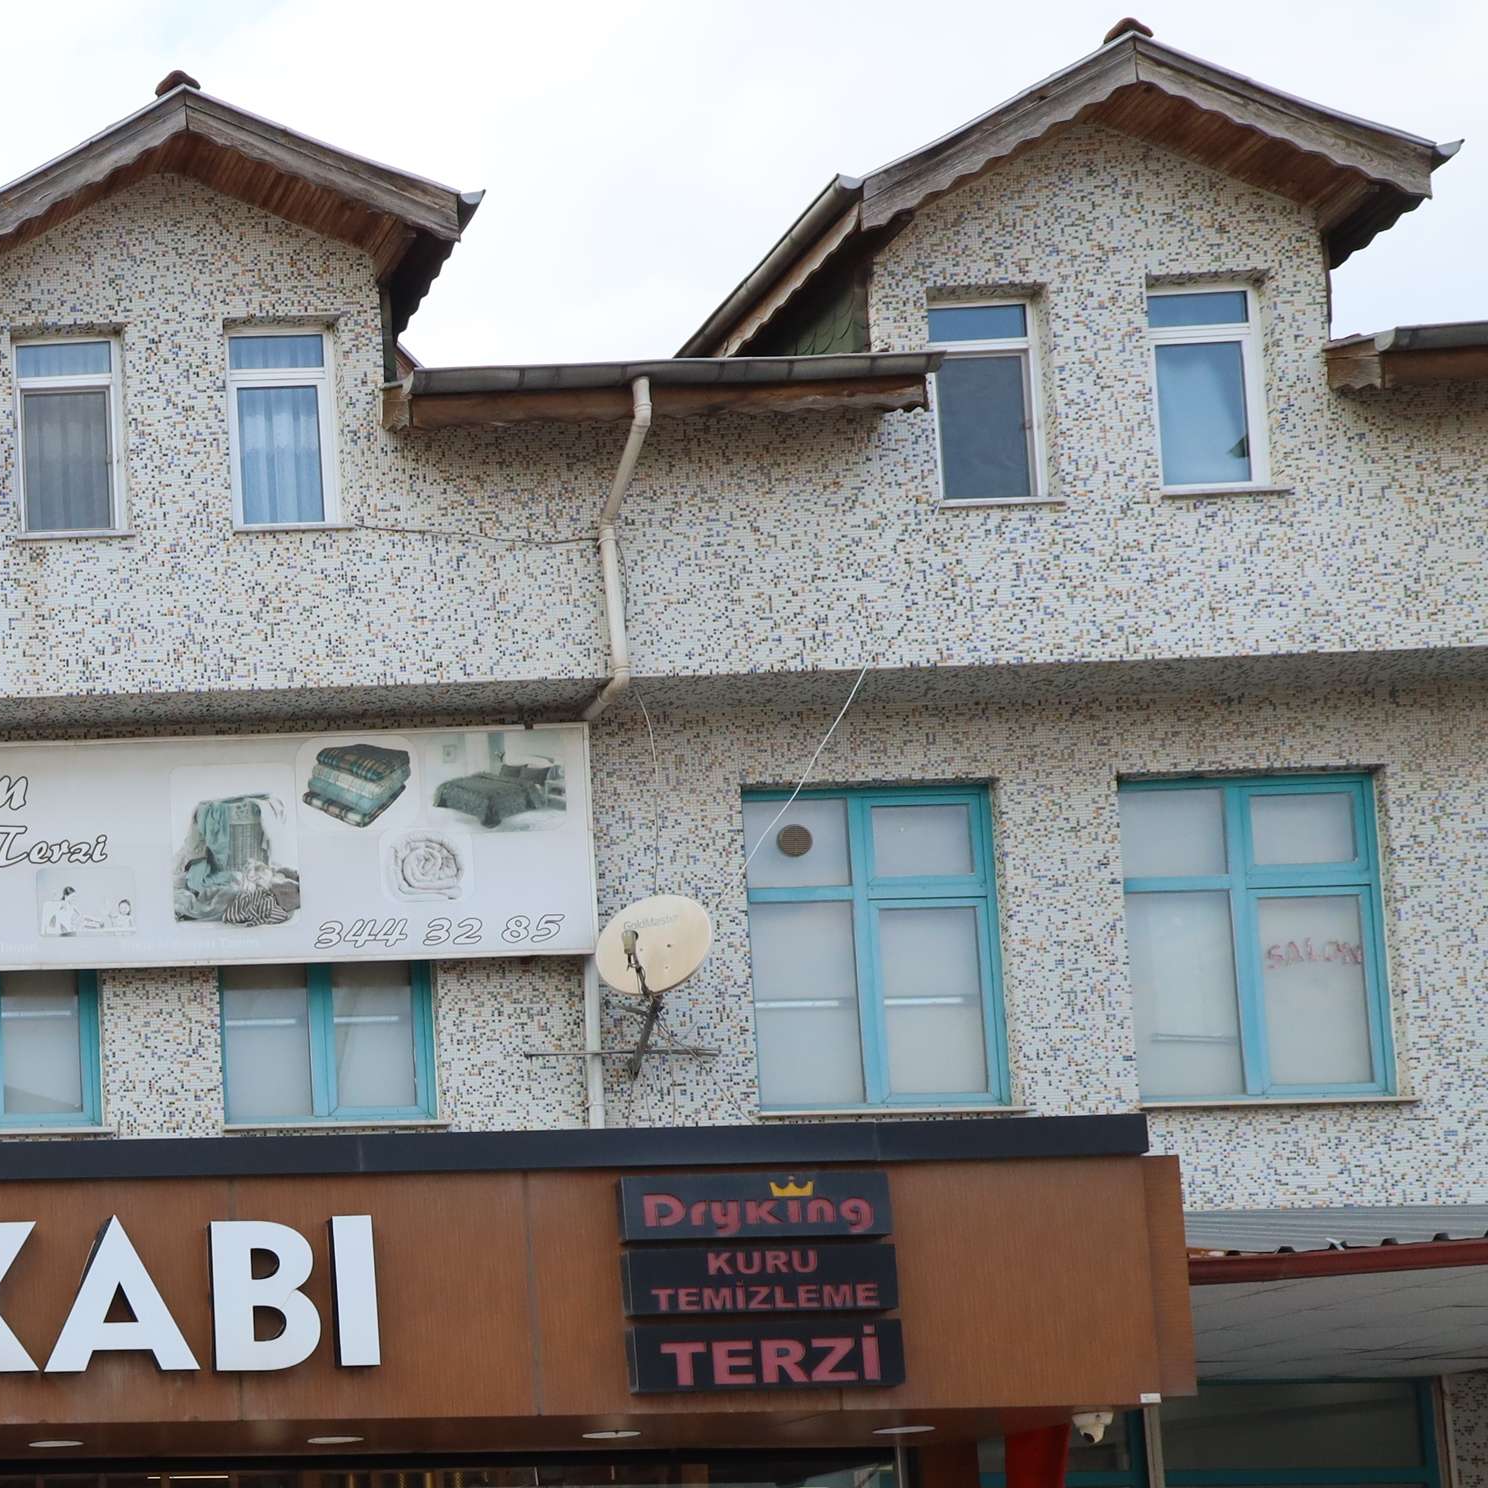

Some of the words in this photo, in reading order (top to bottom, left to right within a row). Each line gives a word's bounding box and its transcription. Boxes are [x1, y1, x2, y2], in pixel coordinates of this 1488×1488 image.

[314, 917, 408, 949] 344
[422, 916, 483, 946] 32
[500, 913, 567, 943] 85
[707, 1250, 818, 1276] KURU
[651, 1279, 881, 1312] TEMİZLEME
[660, 1325, 882, 1386] TERZİ
